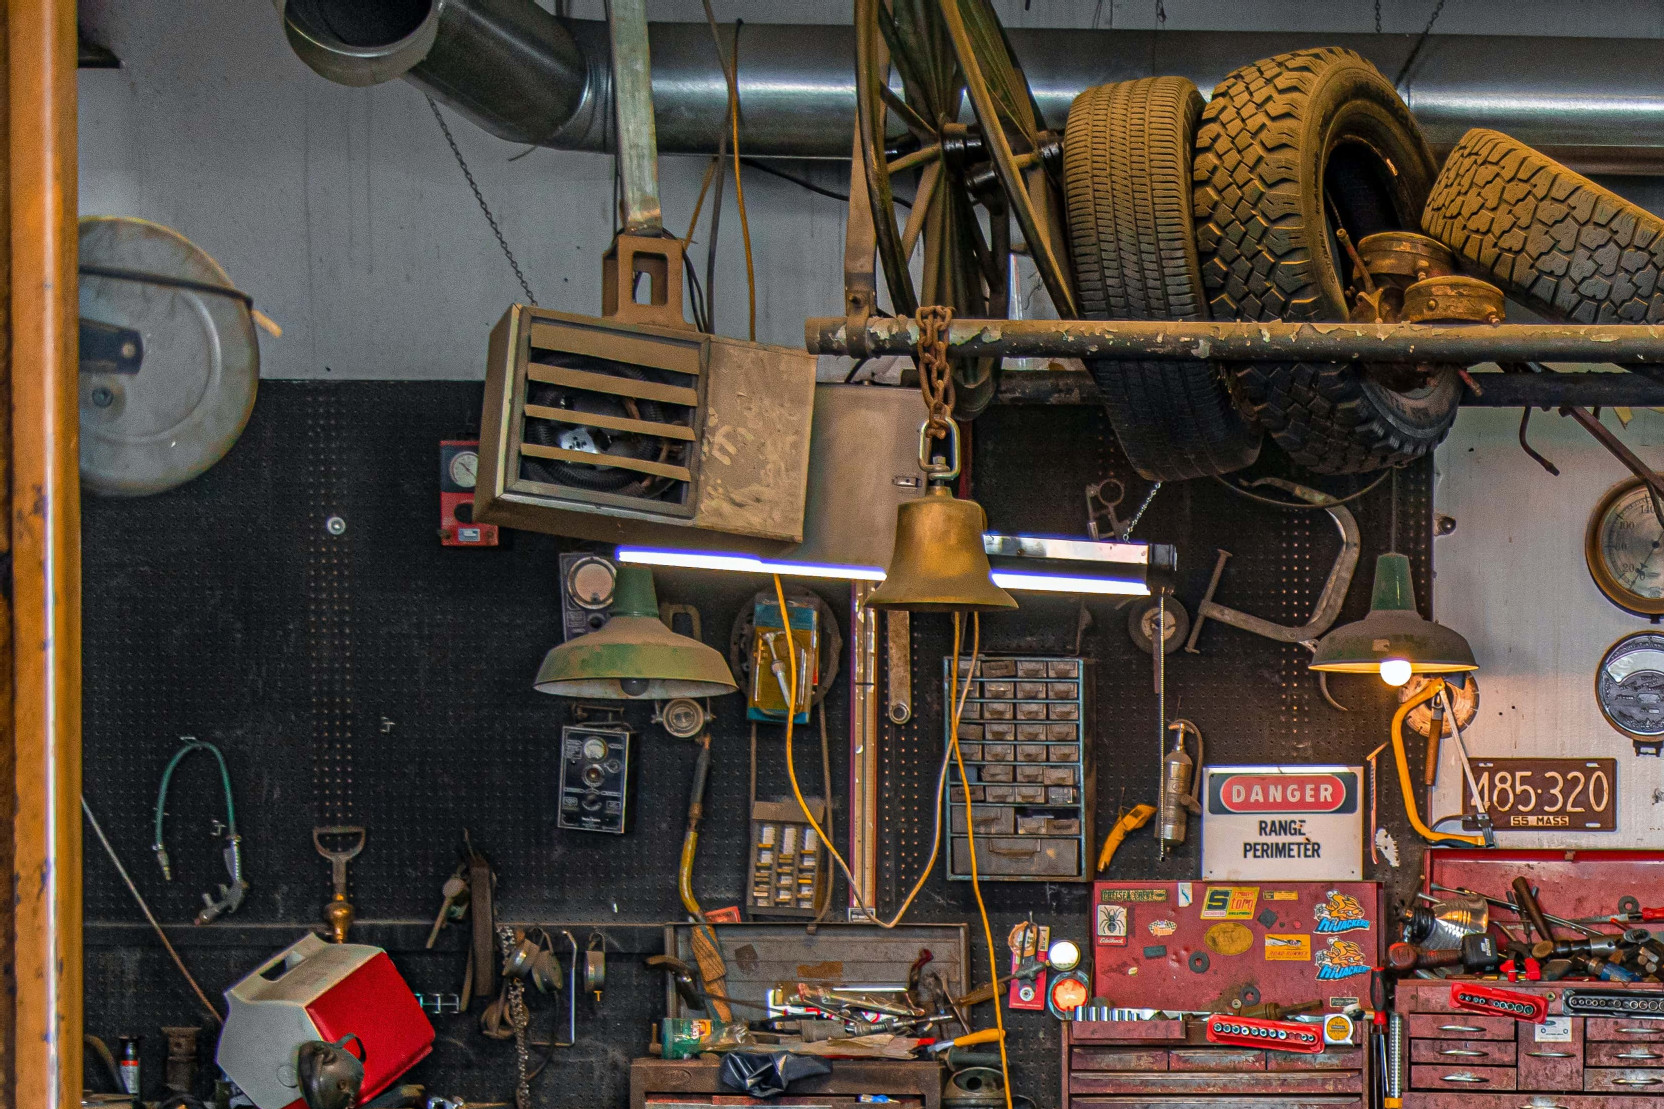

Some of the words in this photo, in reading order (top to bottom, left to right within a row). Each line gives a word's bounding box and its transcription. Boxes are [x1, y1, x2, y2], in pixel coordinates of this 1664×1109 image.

[1232, 784, 1333, 803] DANGER
[1258, 819, 1307, 836] RANGE
[1512, 816, 1529, 826] 55
[1536, 816, 1568, 826] MASS
[1243, 842, 1321, 859] PERIMETER
